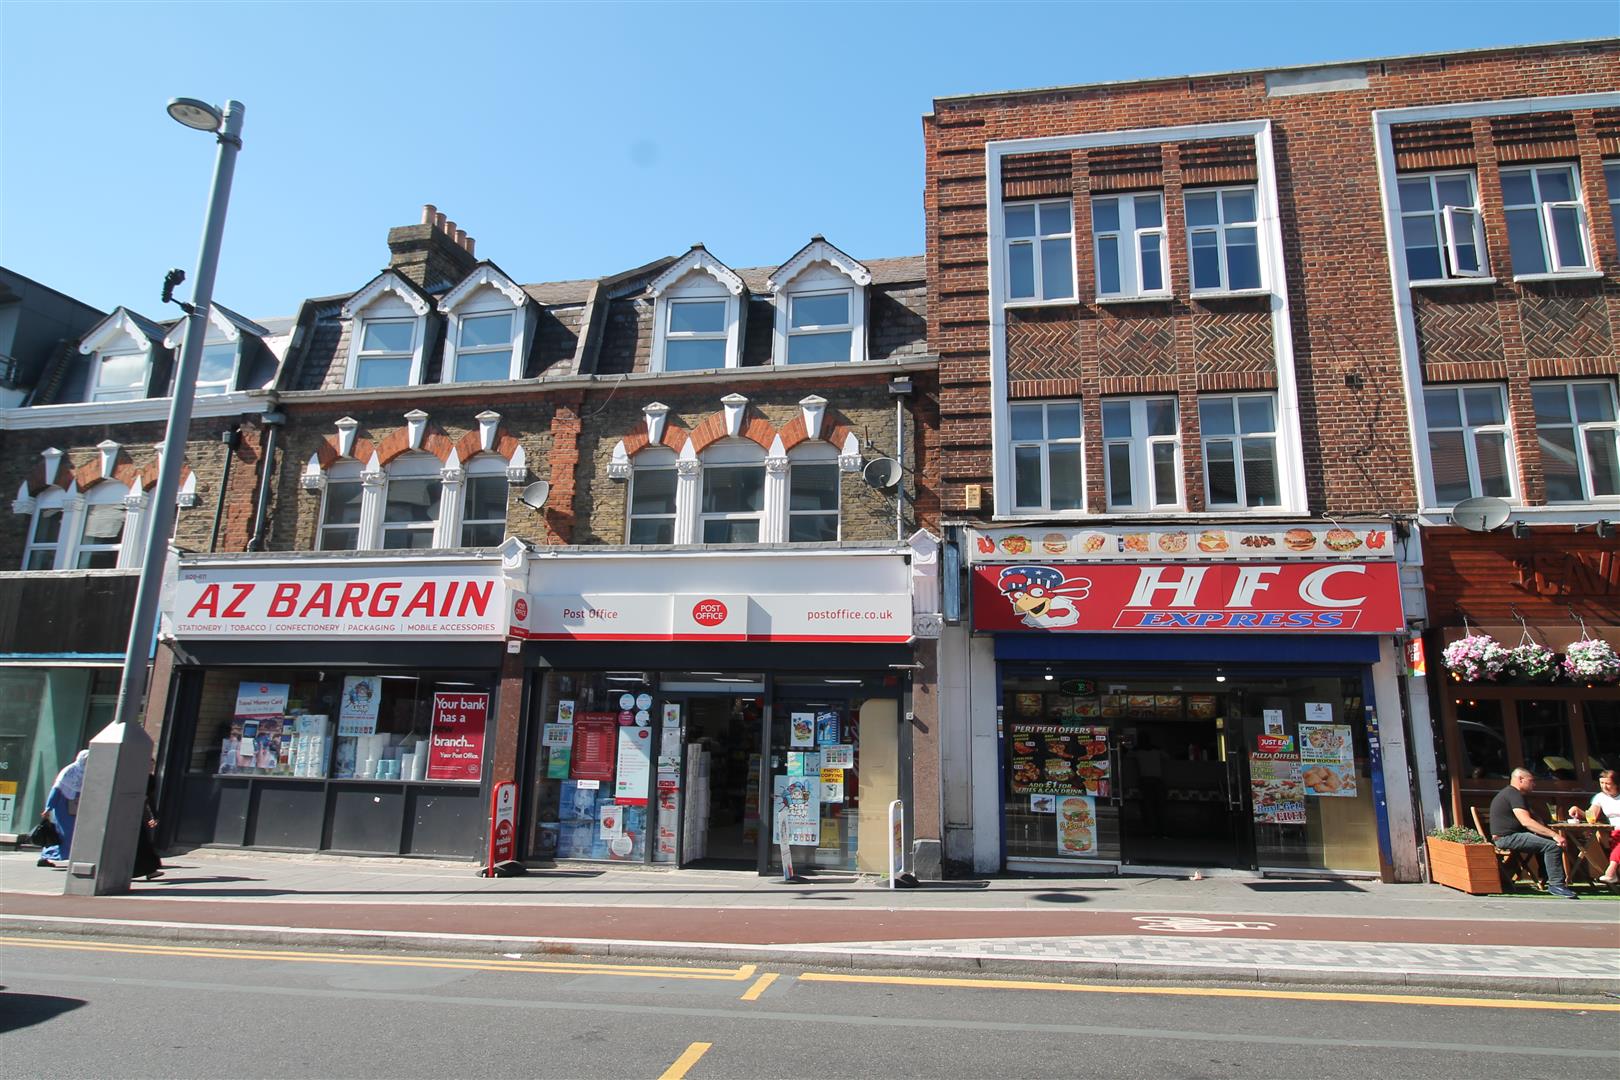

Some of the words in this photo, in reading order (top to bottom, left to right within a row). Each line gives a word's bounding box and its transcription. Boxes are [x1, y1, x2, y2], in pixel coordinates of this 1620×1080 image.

[187, 583, 256, 618] AZ
[266, 580, 495, 618] BARGAIN
[563, 608, 586, 619] Post
[588, 608, 618, 620] Office
[700, 604, 721, 613] POST
[695, 611, 724, 621] OFFICE
[807, 609, 893, 621] postoffice.co.uk
[1137, 612, 1344, 628] EXPRESS
[178, 624, 222, 632] STATIONERY
[407, 623, 438, 631] MOBILE
[440, 623, 496, 631] ACCESSORIES
[437, 697, 458, 710] Your
[461, 697, 485, 709] bank
[440, 712, 457, 723] has
[458, 713, 466, 723] a
[1014, 725, 1034, 733] PERI
[434, 735, 475, 748] branch...
[1261, 738, 1276, 746] JUST
[1276, 811, 1305, 821] FREE
